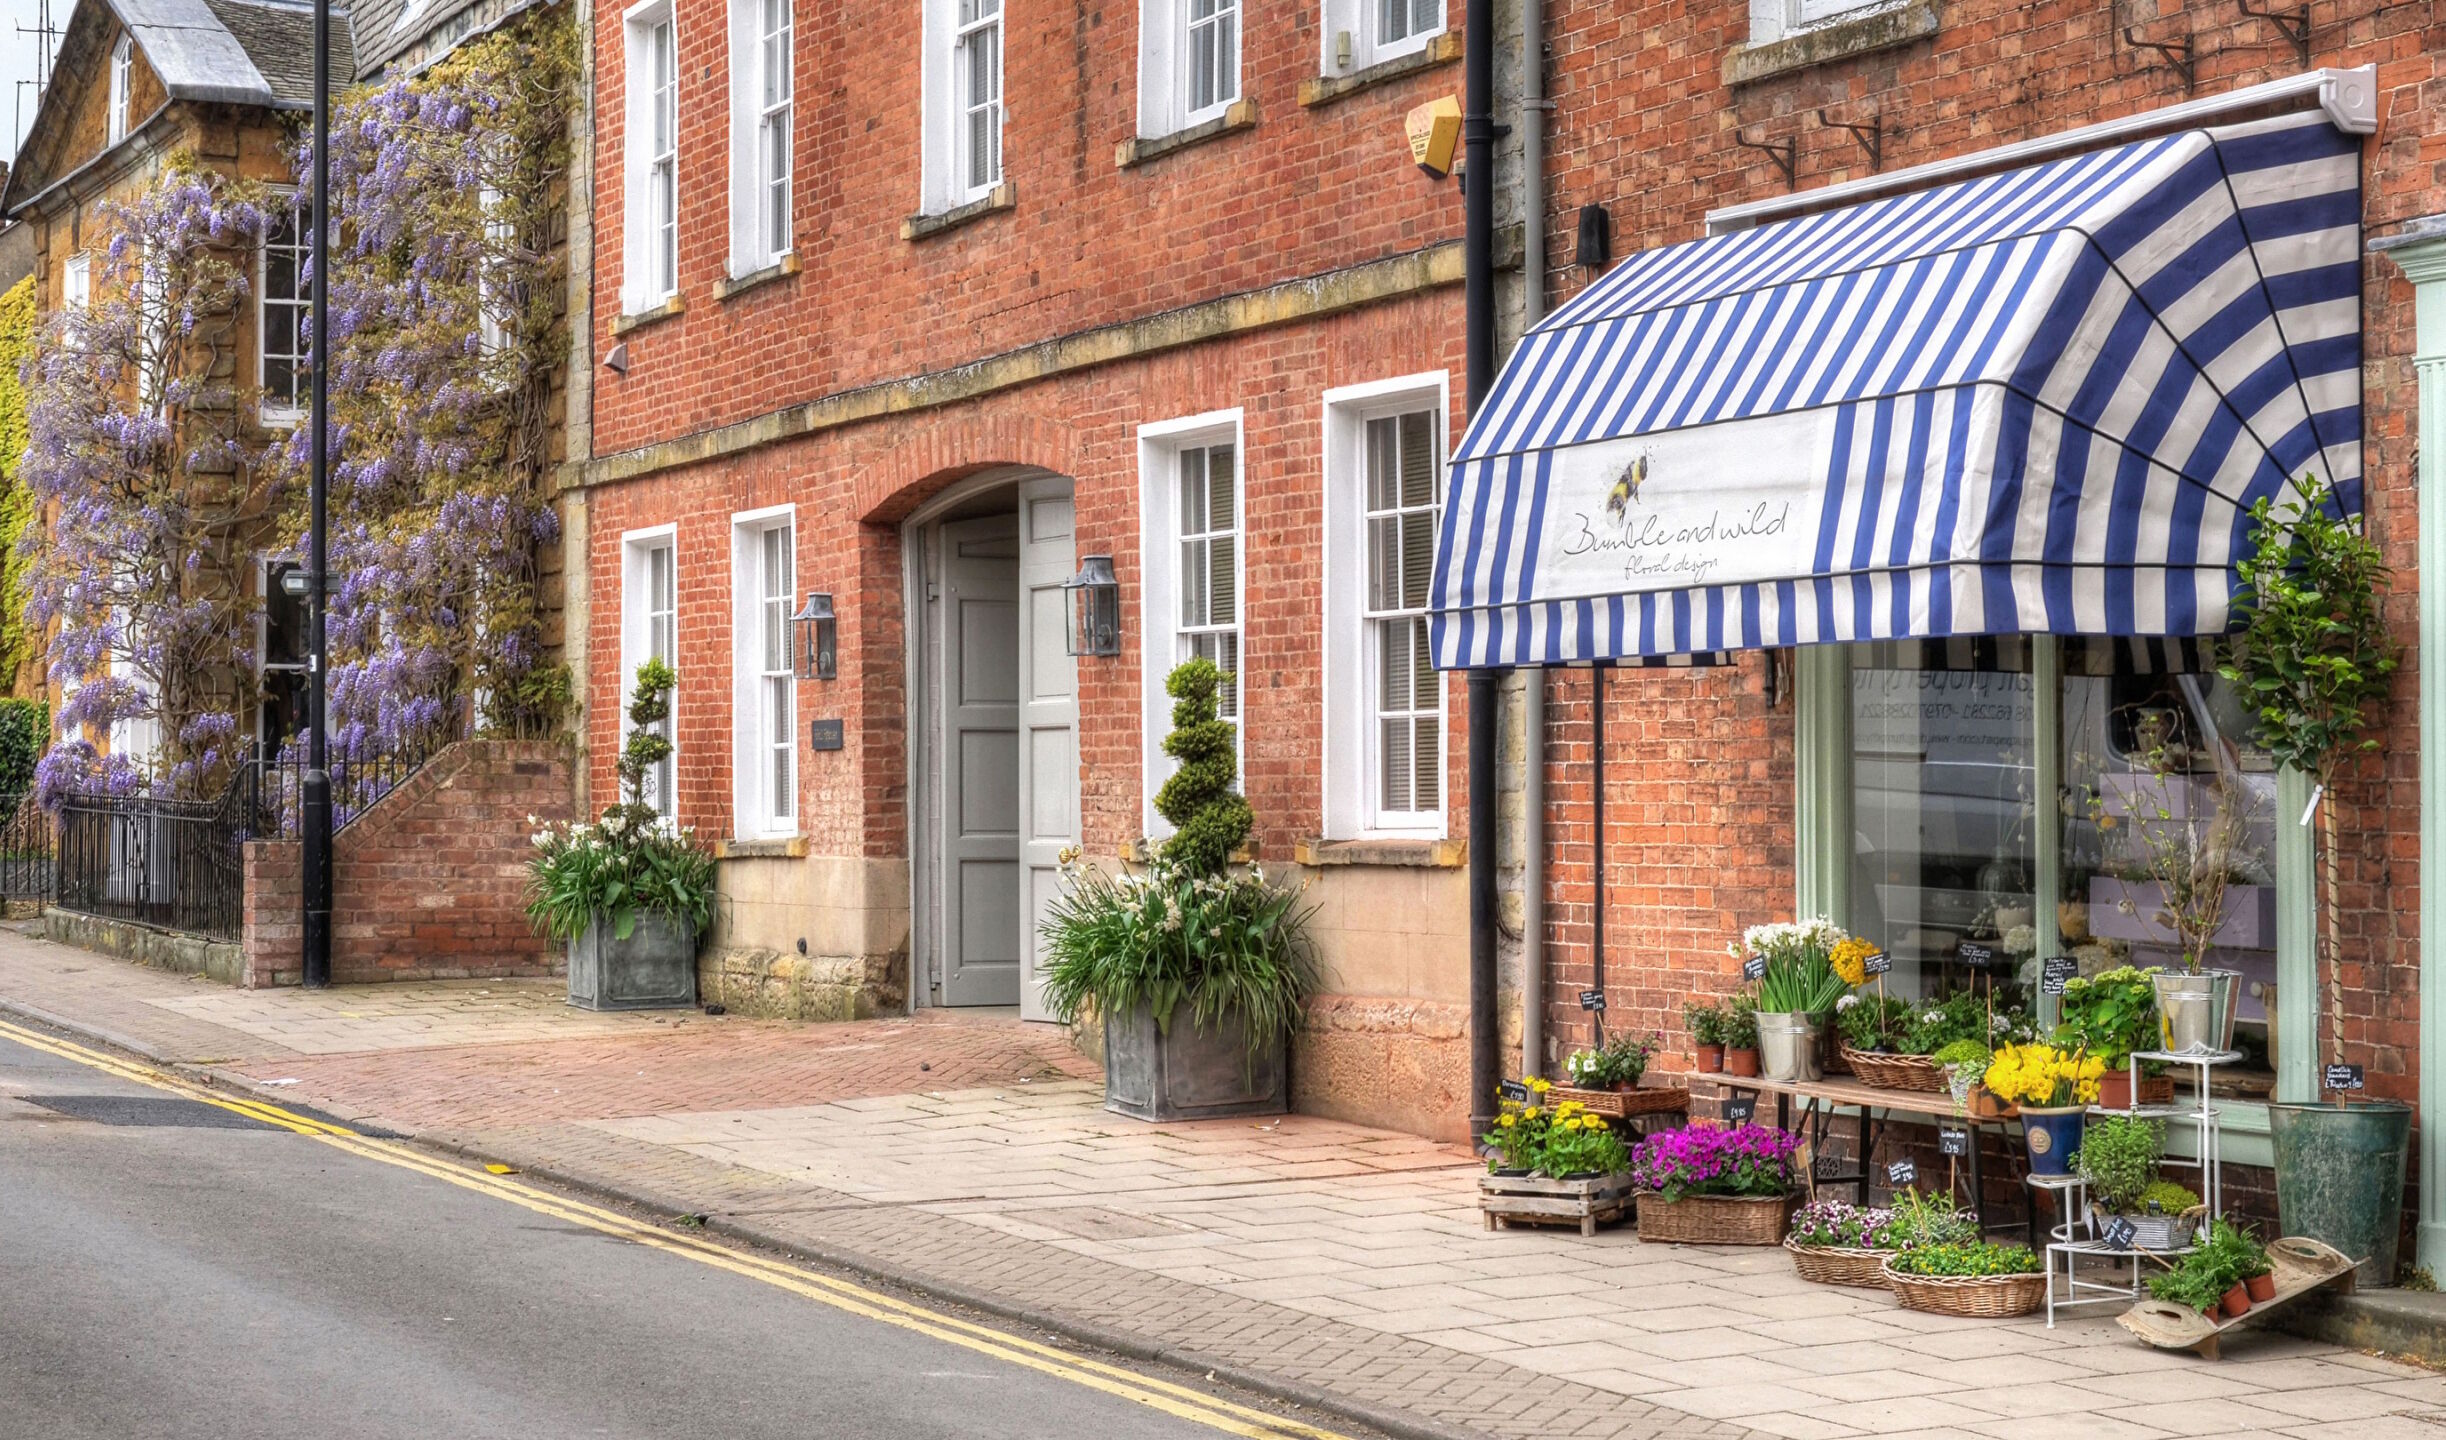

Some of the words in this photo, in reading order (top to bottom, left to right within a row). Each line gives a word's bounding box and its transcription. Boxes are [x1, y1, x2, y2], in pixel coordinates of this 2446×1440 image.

[1564, 513, 1675, 555] Bumble
[1677, 510, 1718, 543] and
[1721, 502, 1789, 540] wild
[1624, 553, 1673, 580] floral
[1674, 553, 1719, 583] design
